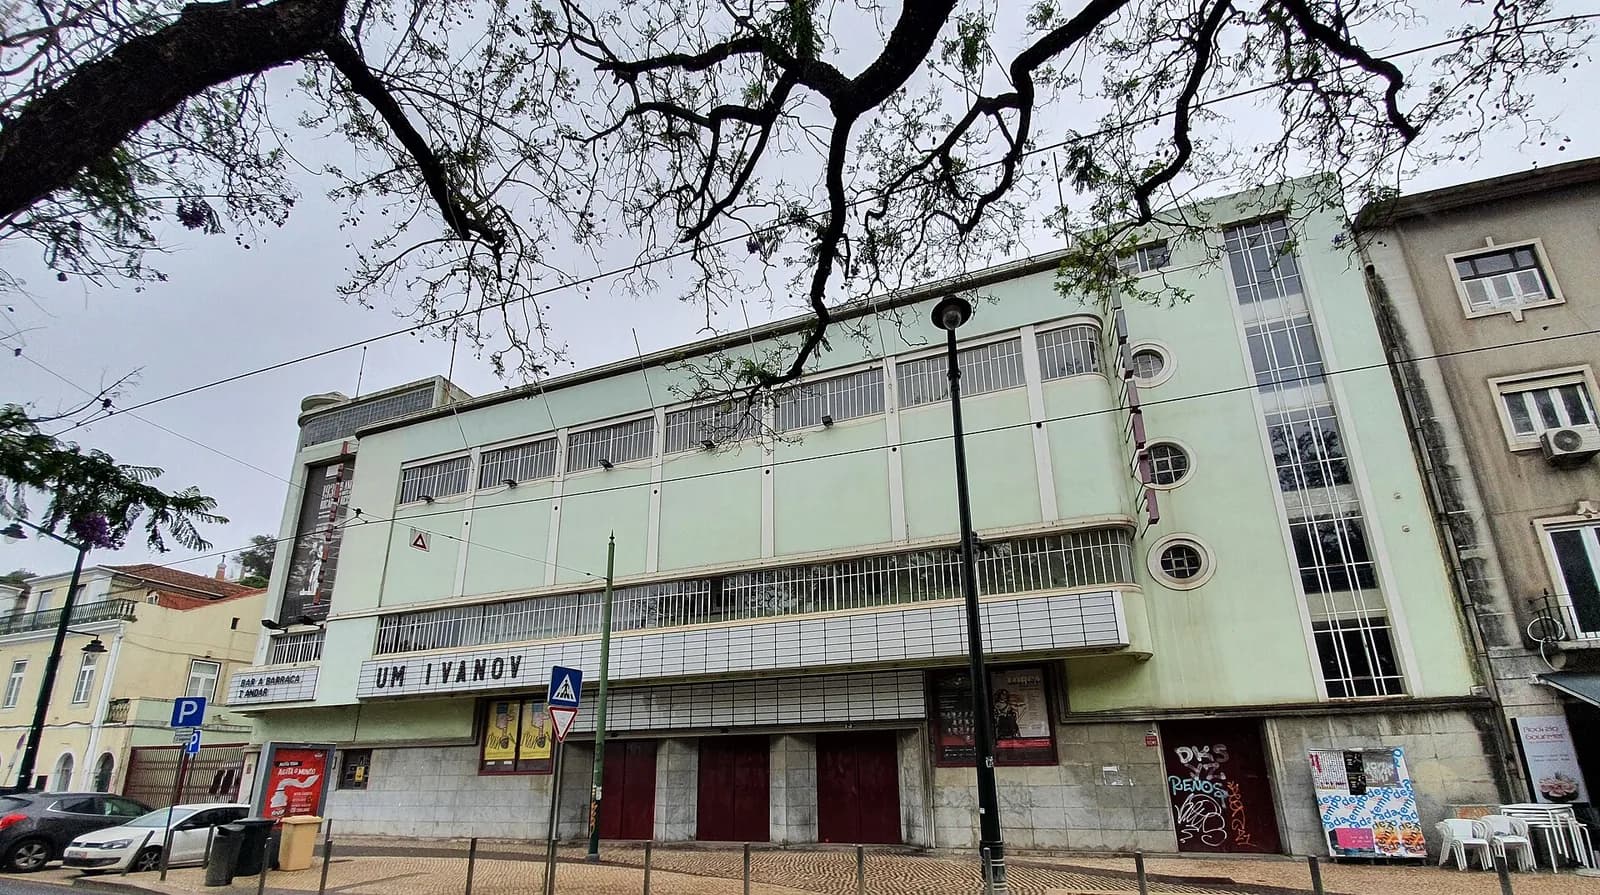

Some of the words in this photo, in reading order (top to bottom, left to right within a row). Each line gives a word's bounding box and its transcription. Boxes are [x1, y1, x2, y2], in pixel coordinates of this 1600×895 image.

[376, 665, 406, 688] UM
[425, 655, 522, 685] IVANOV
[240, 678, 256, 688] BAR
[258, 677, 265, 686] A
[245, 687, 268, 698] ANDAR
[178, 700, 198, 724] P
[189, 732, 198, 752] P
